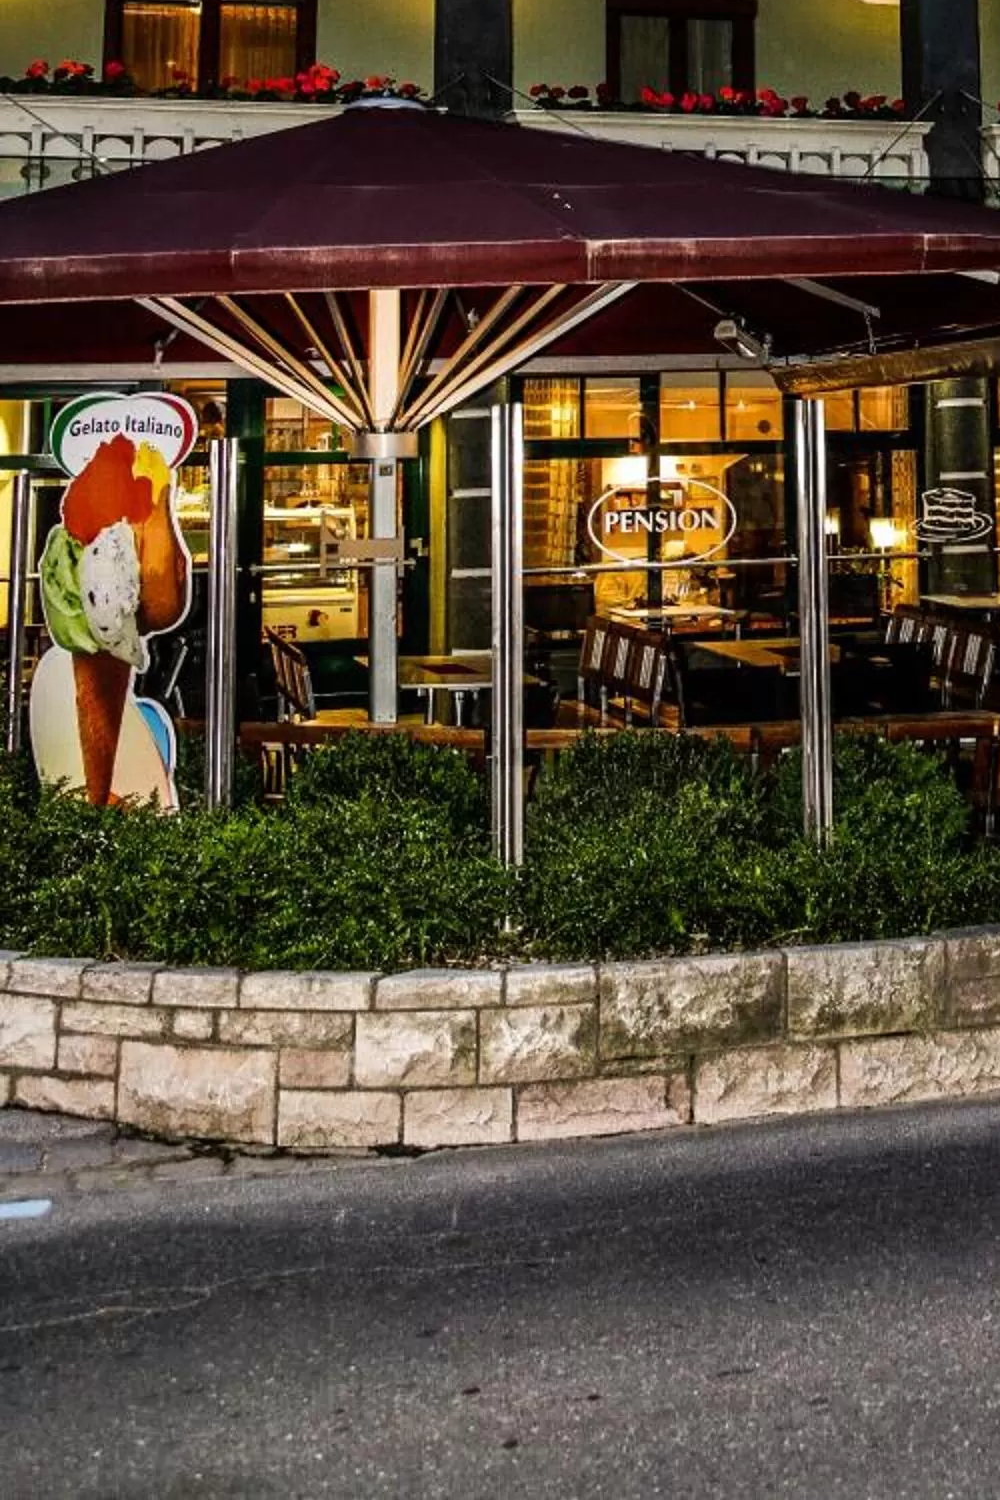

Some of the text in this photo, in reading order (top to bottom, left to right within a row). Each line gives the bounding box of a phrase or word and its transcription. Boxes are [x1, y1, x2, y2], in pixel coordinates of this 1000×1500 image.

[70, 415, 183, 438] Gelato Italiano
[604, 509, 720, 533] PENSION
